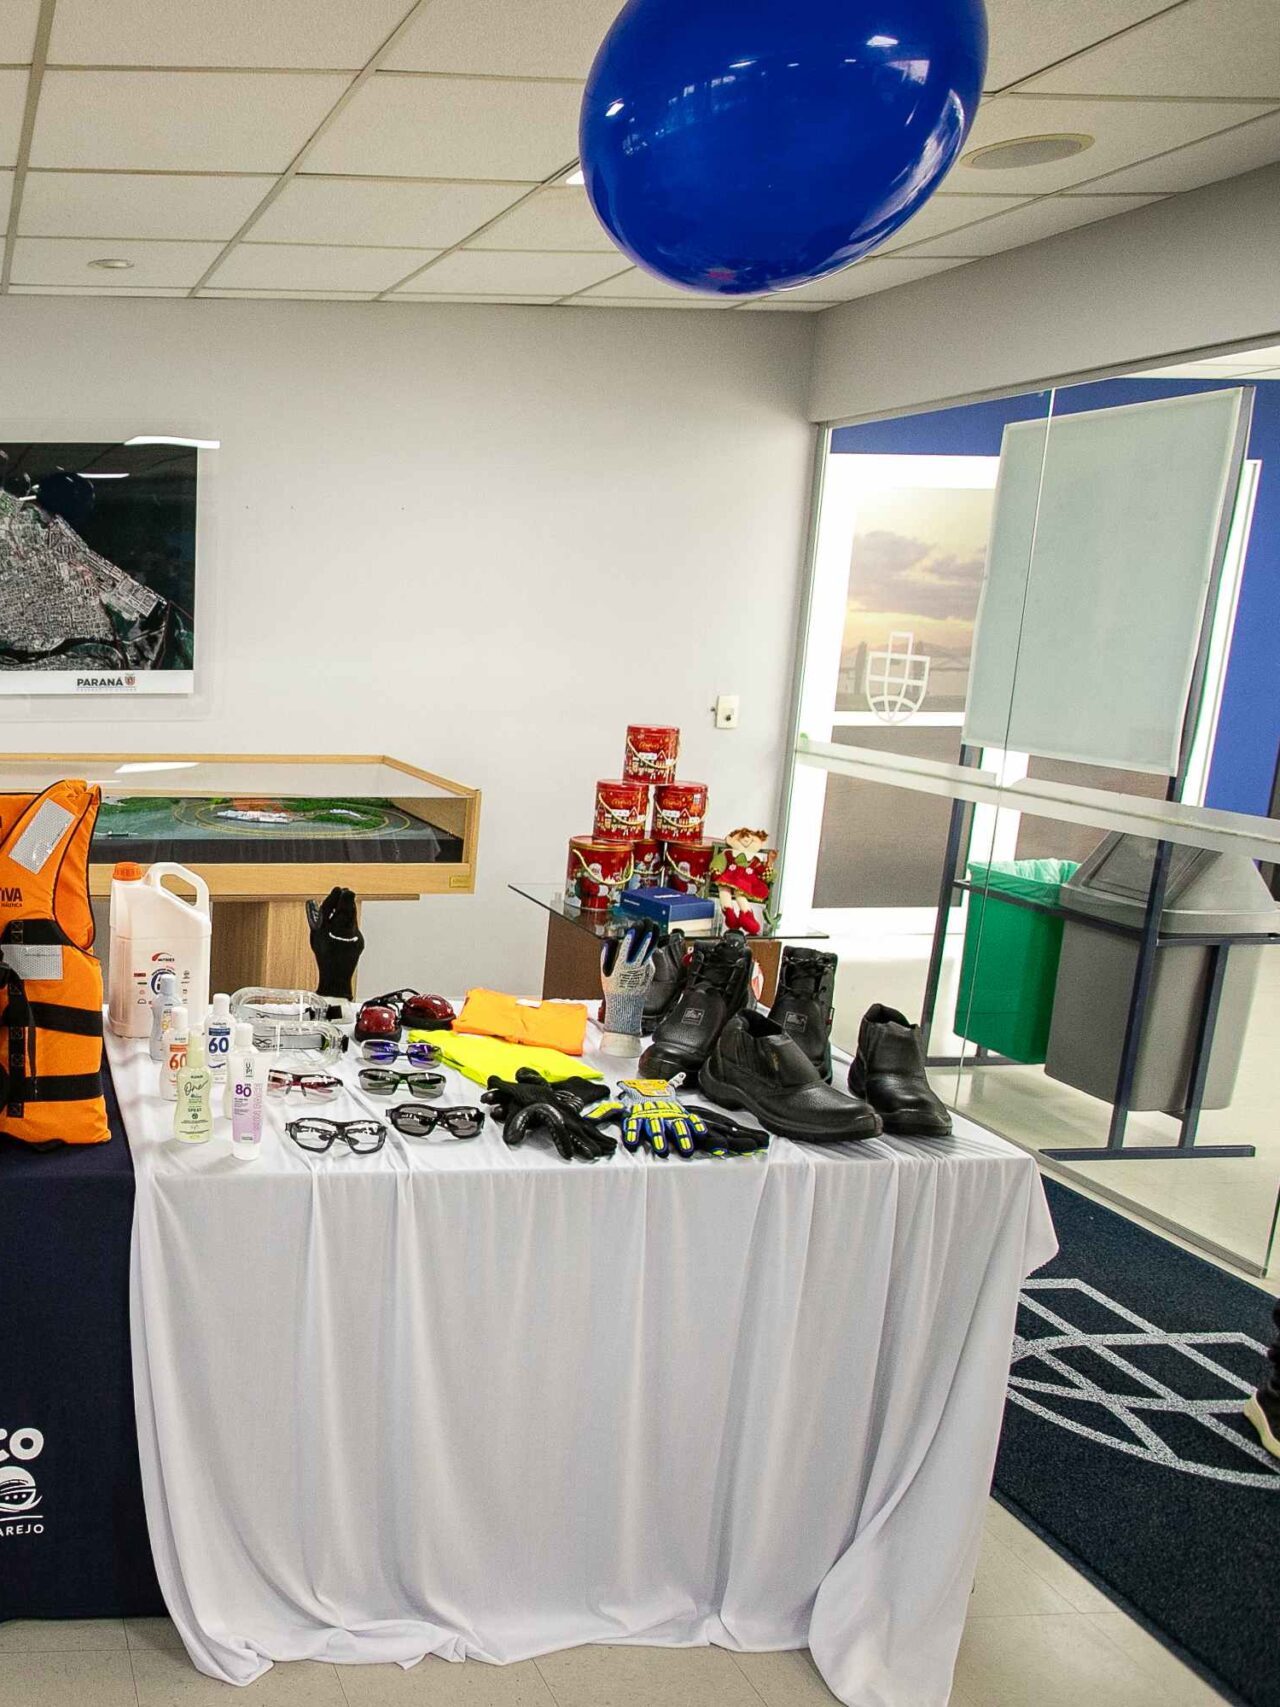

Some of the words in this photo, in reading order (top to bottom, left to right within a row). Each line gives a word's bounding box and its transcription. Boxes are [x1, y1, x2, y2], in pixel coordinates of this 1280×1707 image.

[77, 677, 123, 686] PARANÁ
[208, 1037, 229, 1053] 60
[169, 1053, 186, 1070] 60
[235, 1083, 252, 1098] 80
